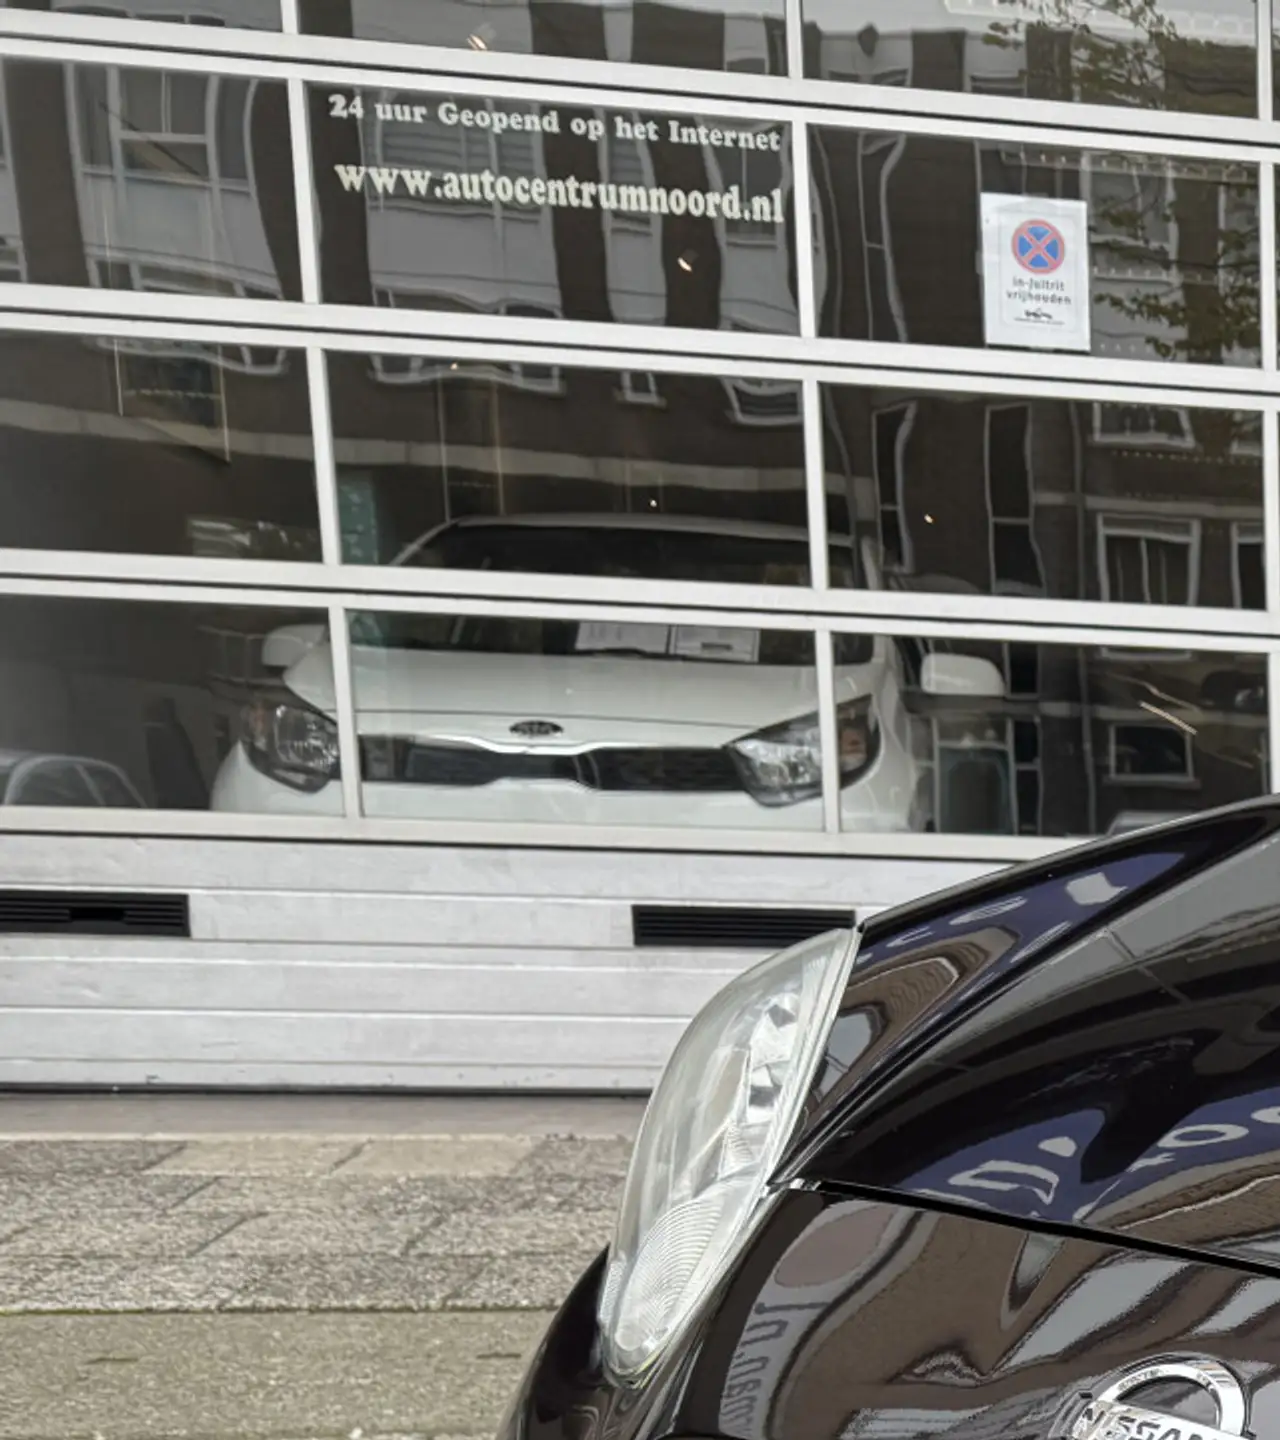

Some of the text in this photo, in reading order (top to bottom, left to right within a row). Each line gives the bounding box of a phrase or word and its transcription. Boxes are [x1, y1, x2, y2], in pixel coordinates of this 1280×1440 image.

[328, 93, 781, 150] 24 uur Geopend op het Internet
[334, 163, 784, 223] www.autocentrumnoord.nl
